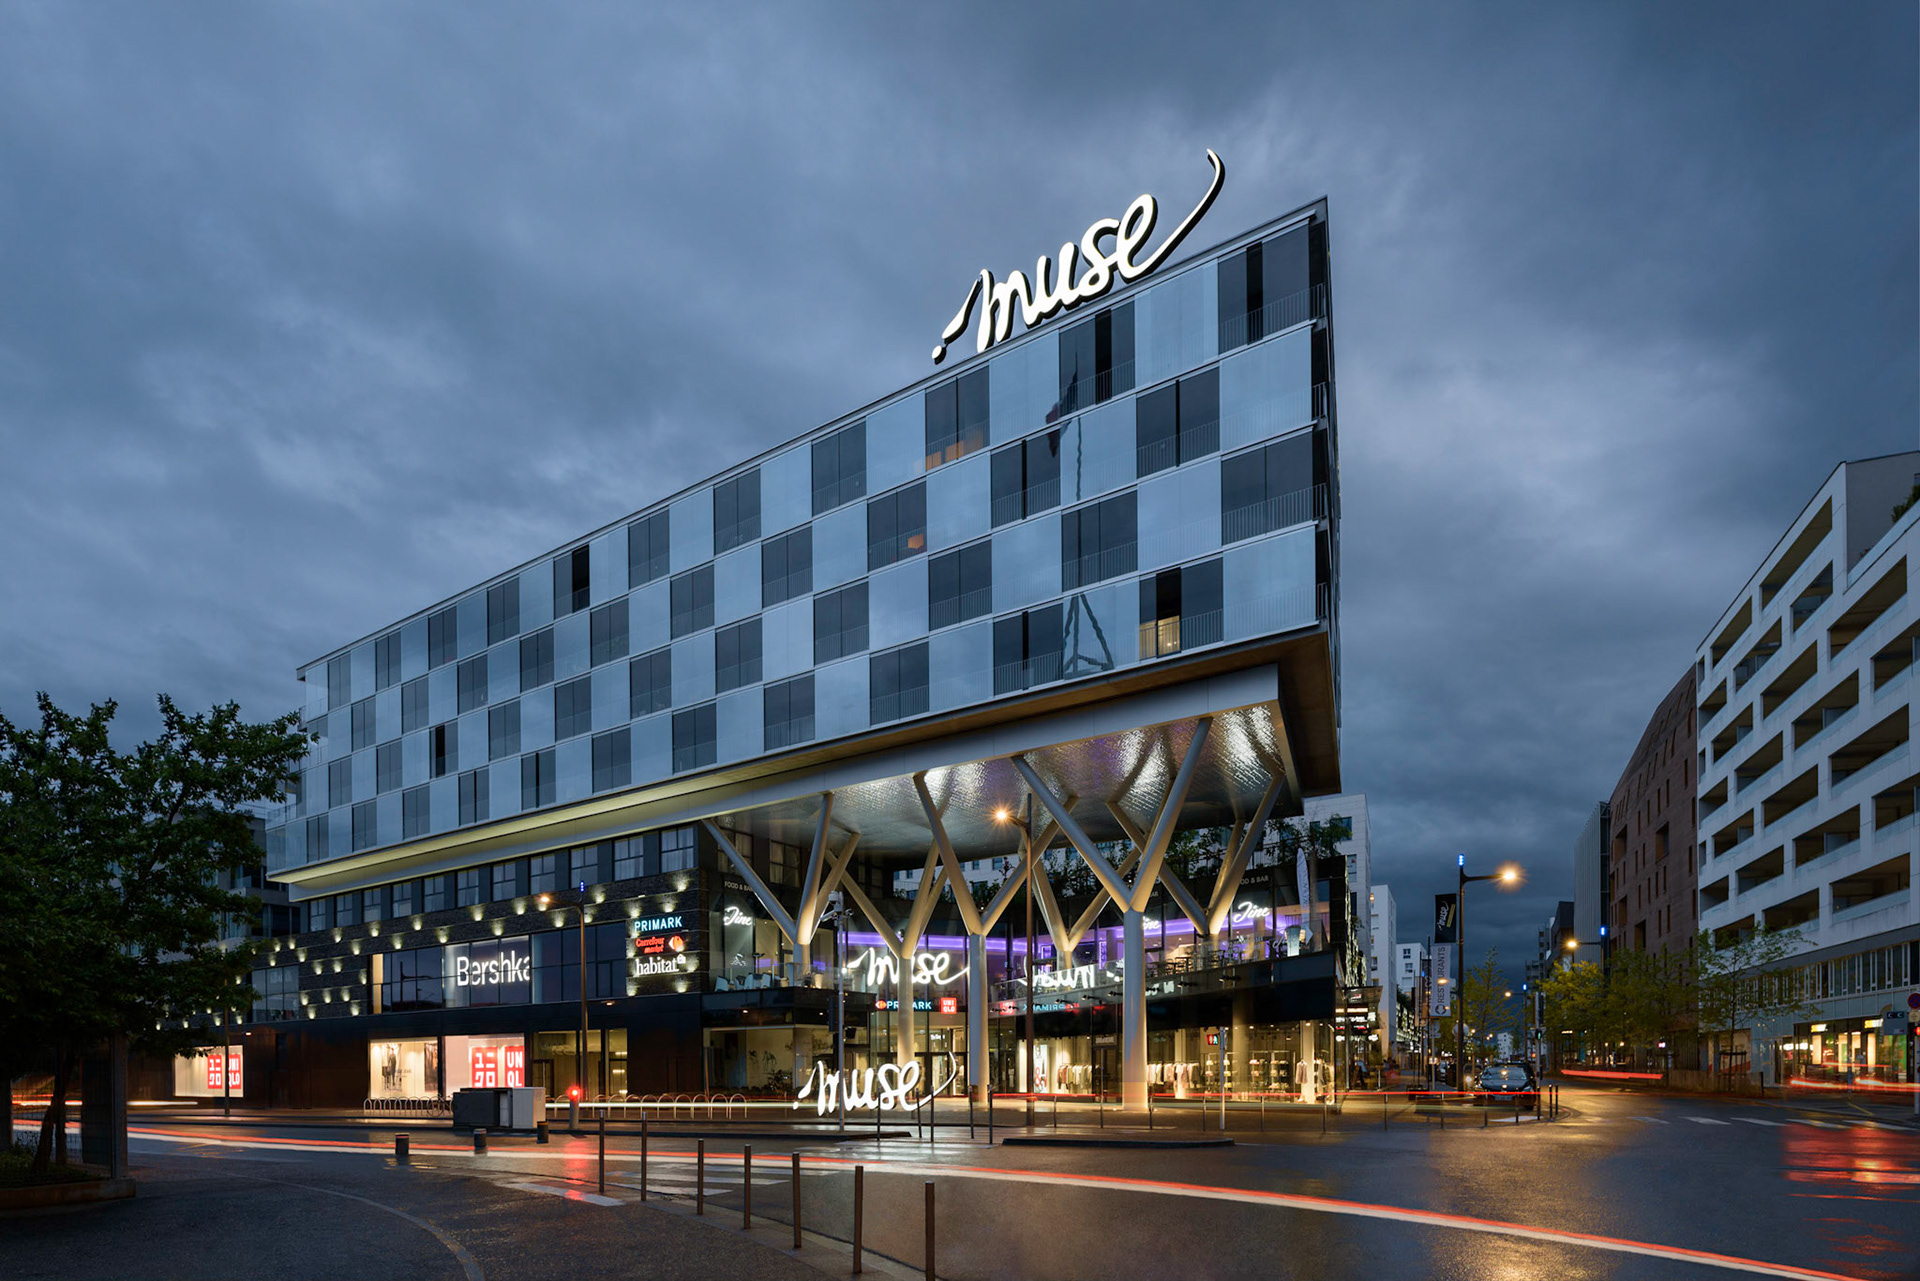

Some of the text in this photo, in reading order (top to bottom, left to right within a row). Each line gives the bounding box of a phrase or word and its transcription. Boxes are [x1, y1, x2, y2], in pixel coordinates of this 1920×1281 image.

[932, 148, 1226, 365] muse
[724, 881, 739, 890] FOOD
[744, 884, 753, 892] BA
[634, 916, 683, 932] PRIMARK
[457, 950, 530, 987] Bershka
[635, 956, 679, 976] habitat
[1437, 946, 1446, 1003] RESTURANTS
[887, 1001, 932, 1010] PRARK
[793, 1051, 957, 1117] muse
